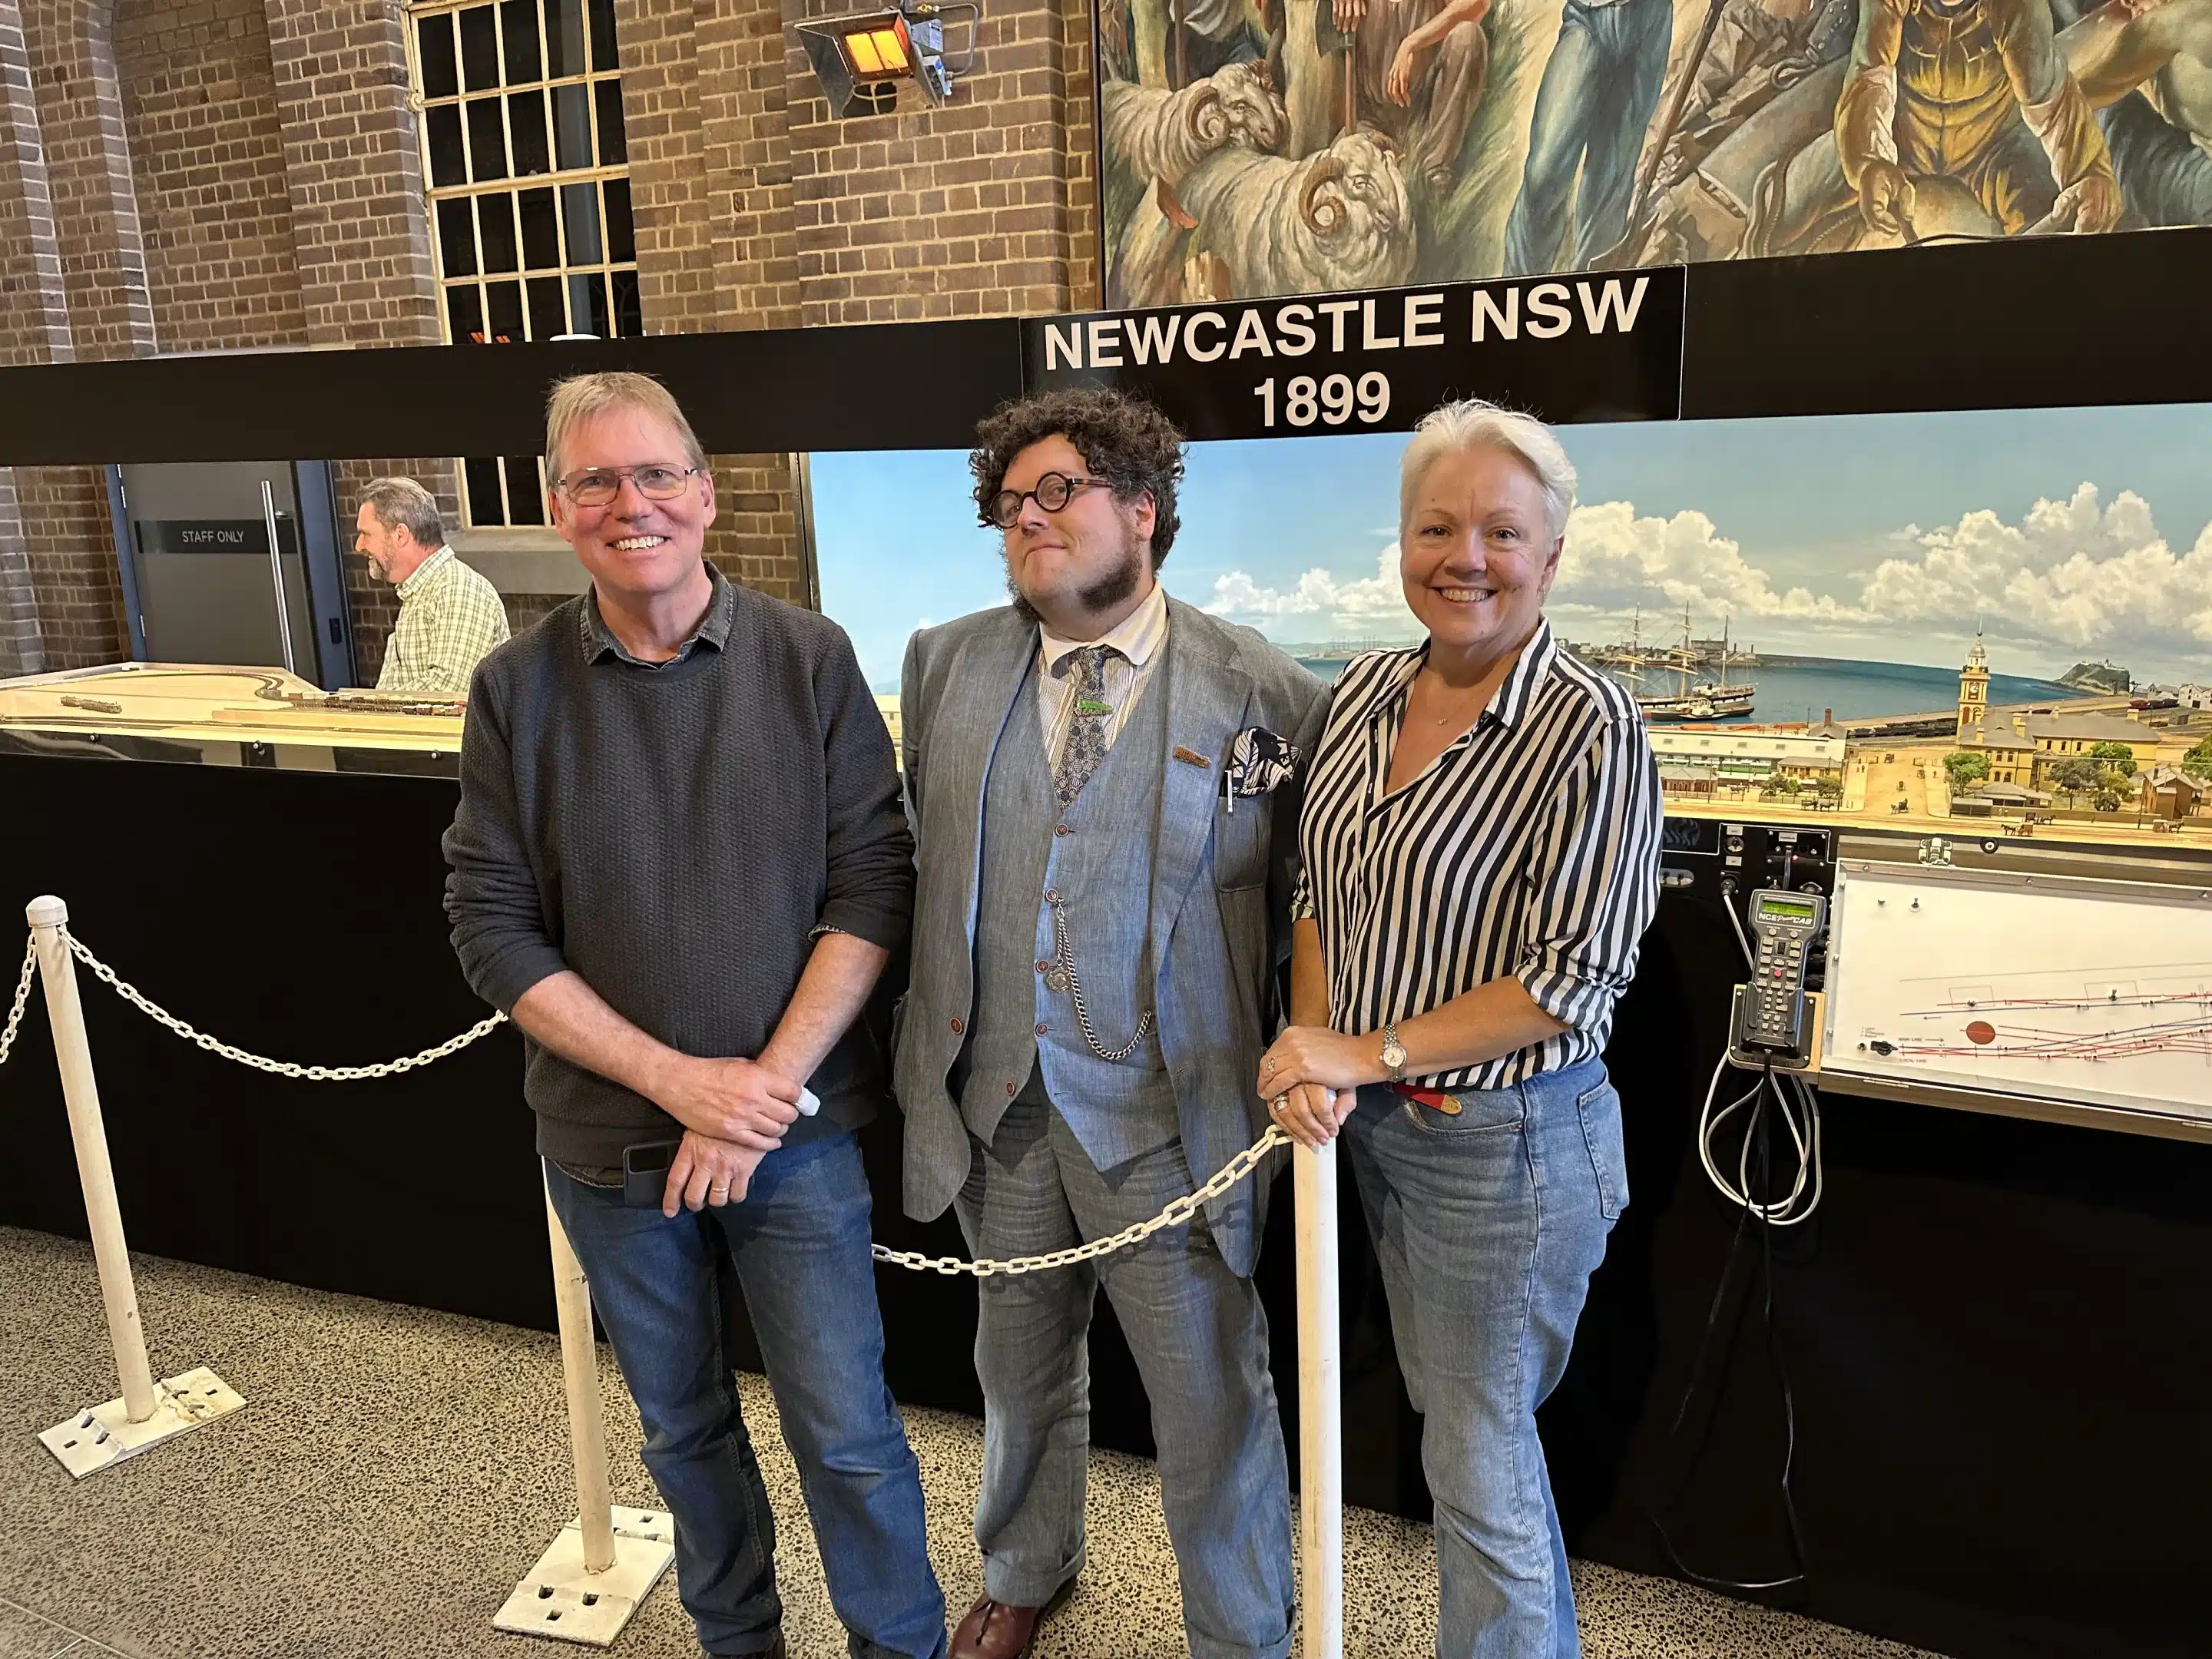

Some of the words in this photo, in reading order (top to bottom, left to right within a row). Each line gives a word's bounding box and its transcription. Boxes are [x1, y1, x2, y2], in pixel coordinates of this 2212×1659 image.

[1045, 293, 1445, 371] NEWCASTLE
[1472, 276, 1650, 343] NSW
[1254, 371, 1390, 427] 1899
[181, 530, 215, 543] STAFF
[217, 530, 244, 543] ONLY
[1758, 912, 1777, 921] NCE
[1793, 916, 1813, 925] CAB
